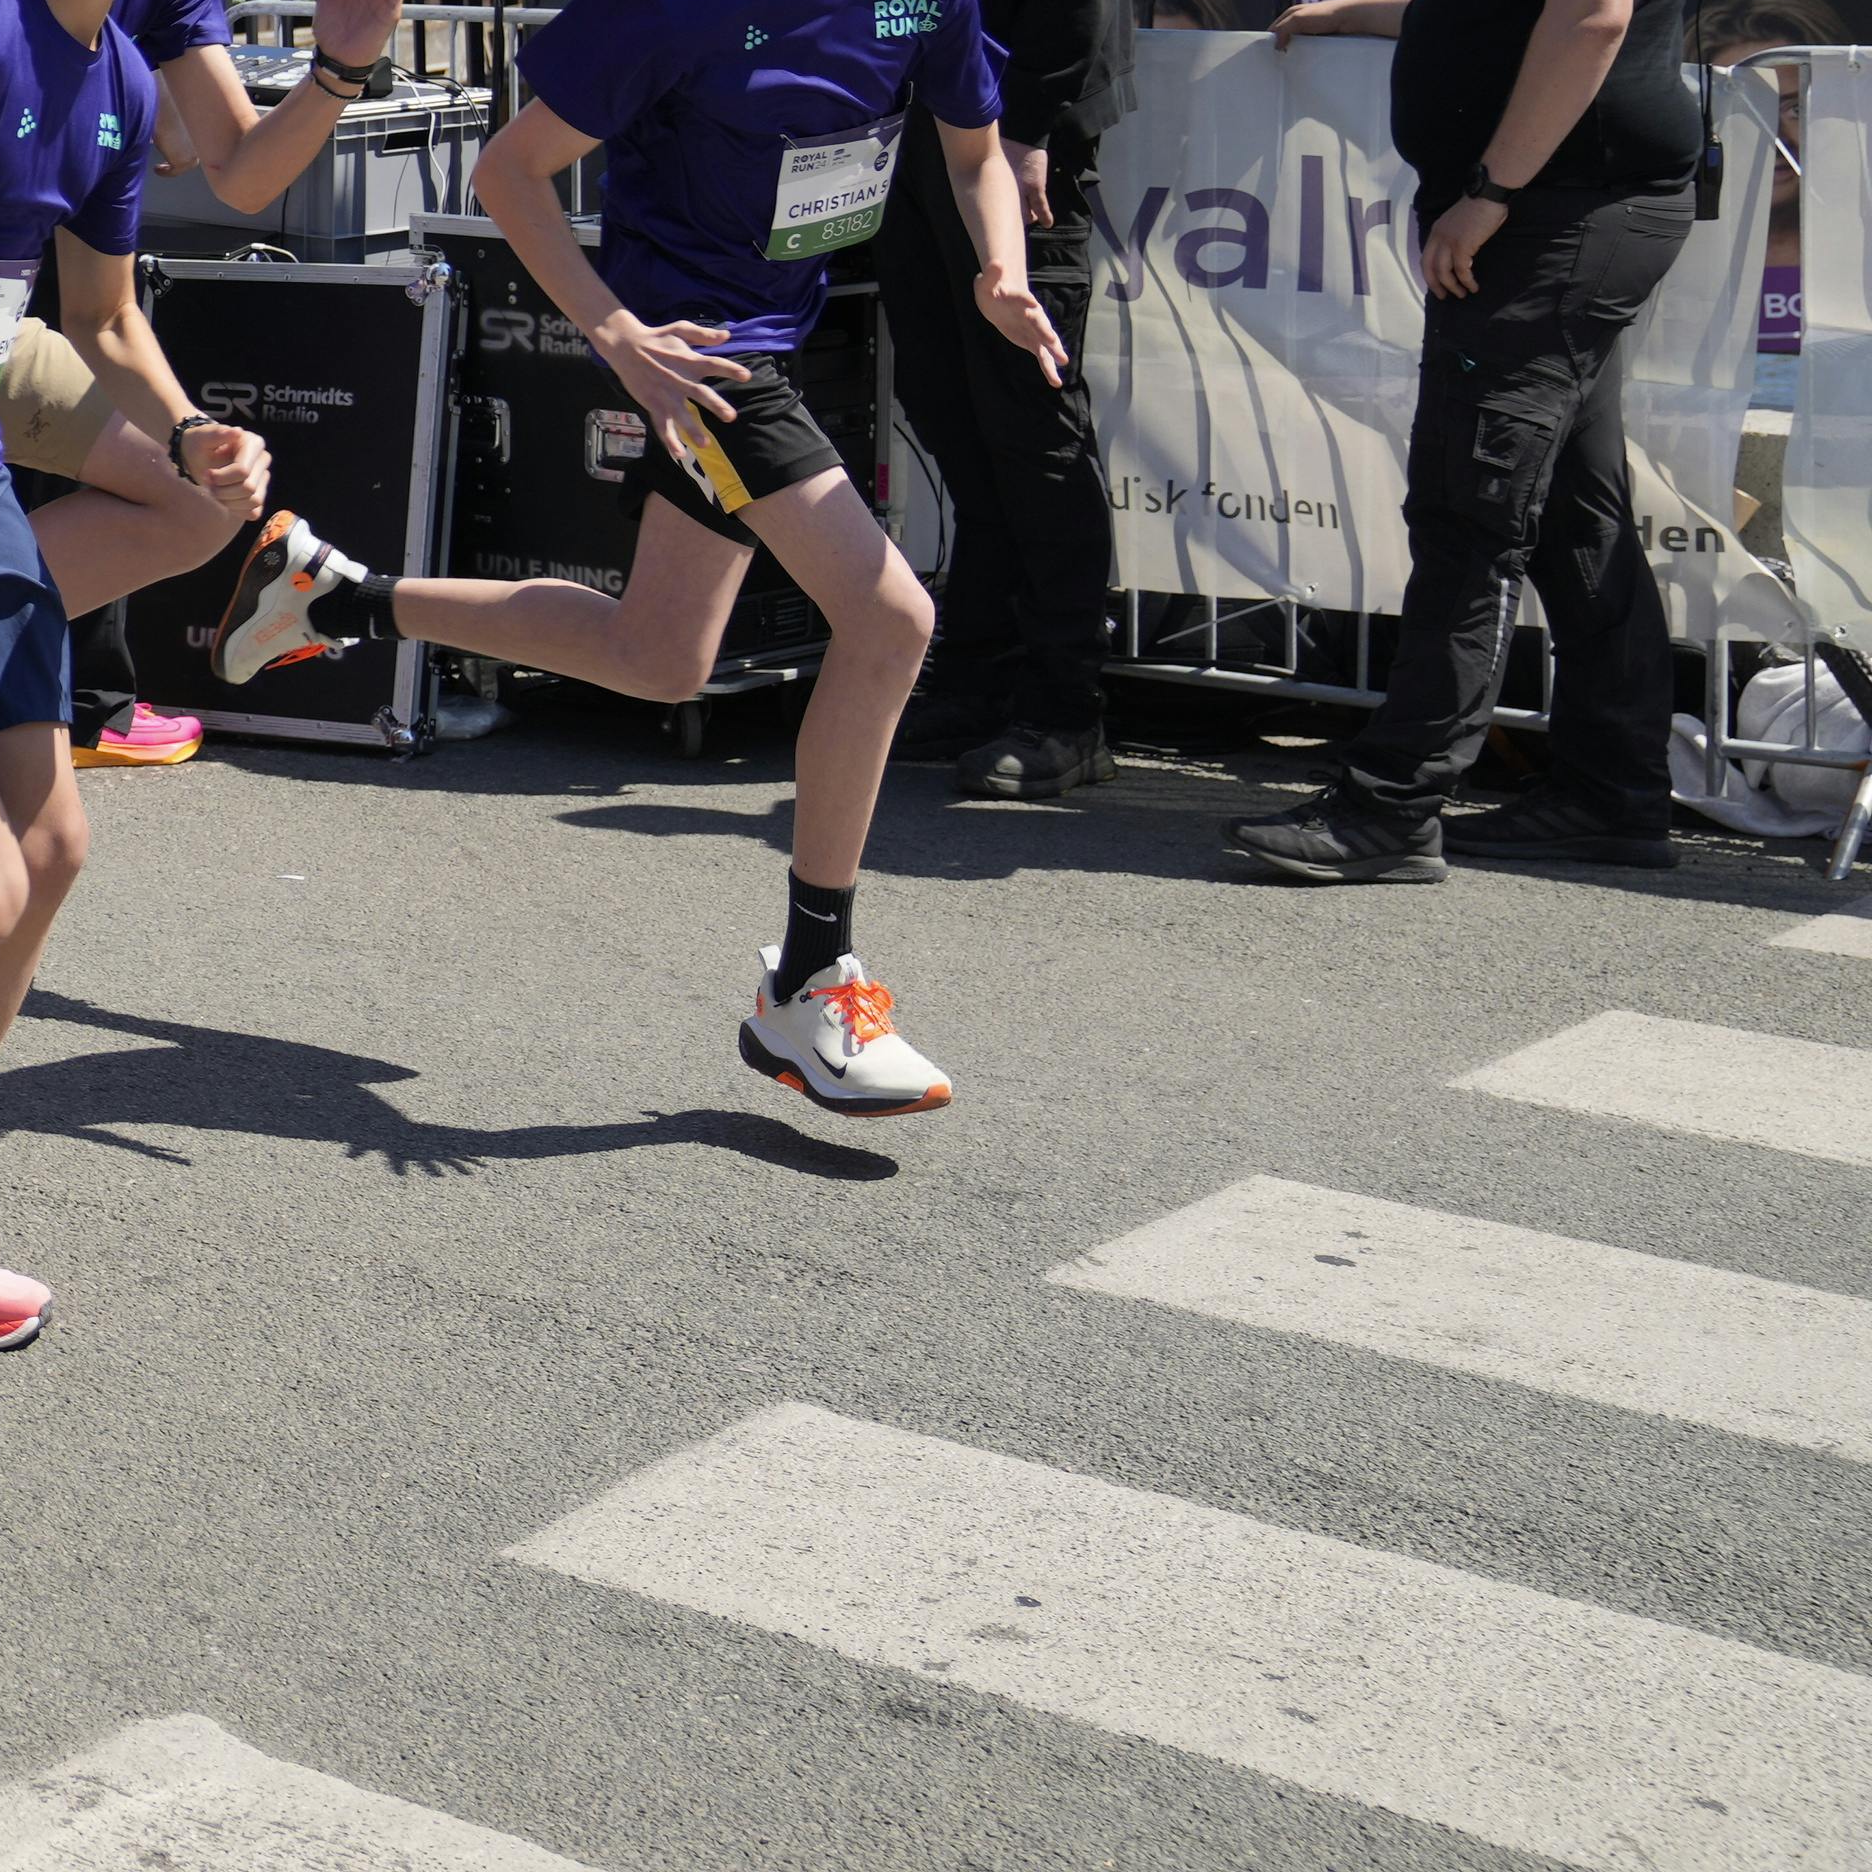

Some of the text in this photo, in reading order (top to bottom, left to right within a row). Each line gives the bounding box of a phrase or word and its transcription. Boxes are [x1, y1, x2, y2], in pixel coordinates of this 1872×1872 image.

[875, 16, 919, 39] RUN
[793, 151, 828, 165] ROYAL
[788, 183, 878, 220] CHRISTIAN
[786, 233, 802, 249] C
[821, 210, 874, 241] 83182
[201, 382, 354, 420] SR Schmidts
[262, 405, 319, 424] Radio
[1201, 481, 1338, 529] fonden
